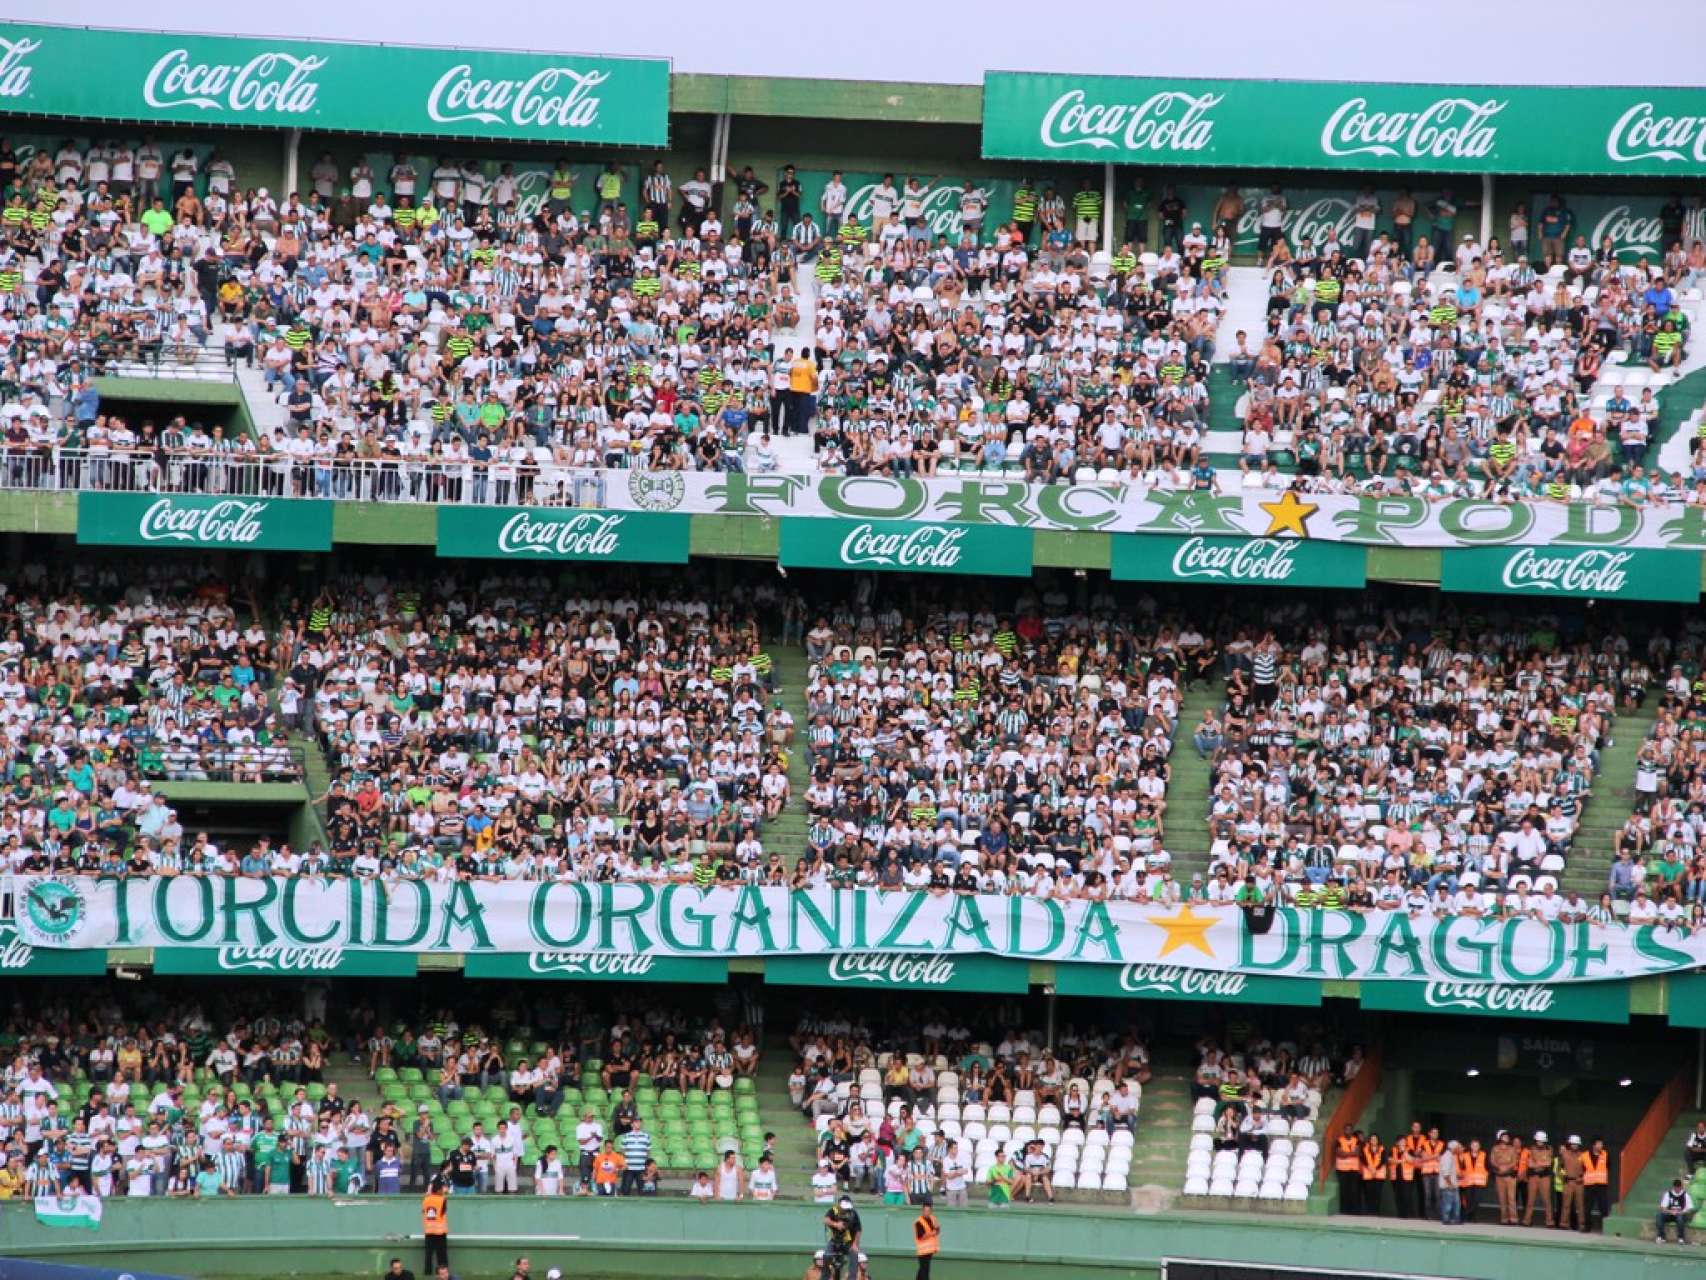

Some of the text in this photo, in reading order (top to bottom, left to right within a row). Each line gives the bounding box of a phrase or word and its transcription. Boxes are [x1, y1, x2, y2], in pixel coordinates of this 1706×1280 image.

[0, 36, 42, 97] la
[144, 49, 326, 113] Coca-Cola
[428, 64, 610, 128] Coca-Cola
[1041, 89, 1225, 152] Coca-Cola
[1320, 98, 1509, 159] Coca-Cola
[1607, 102, 1706, 162] Coca-
[140, 498, 269, 543] Coca-Cola
[498, 511, 627, 555] Coca-Cola
[840, 523, 970, 568] Coca-Cola
[1172, 536, 1301, 580] Coca-Cola
[1502, 548, 1635, 592] Coca-Cola
[95, 875, 497, 950] TORCIDA
[530, 880, 1124, 960] ORGANIZADA
[0, 935, 35, 968] la
